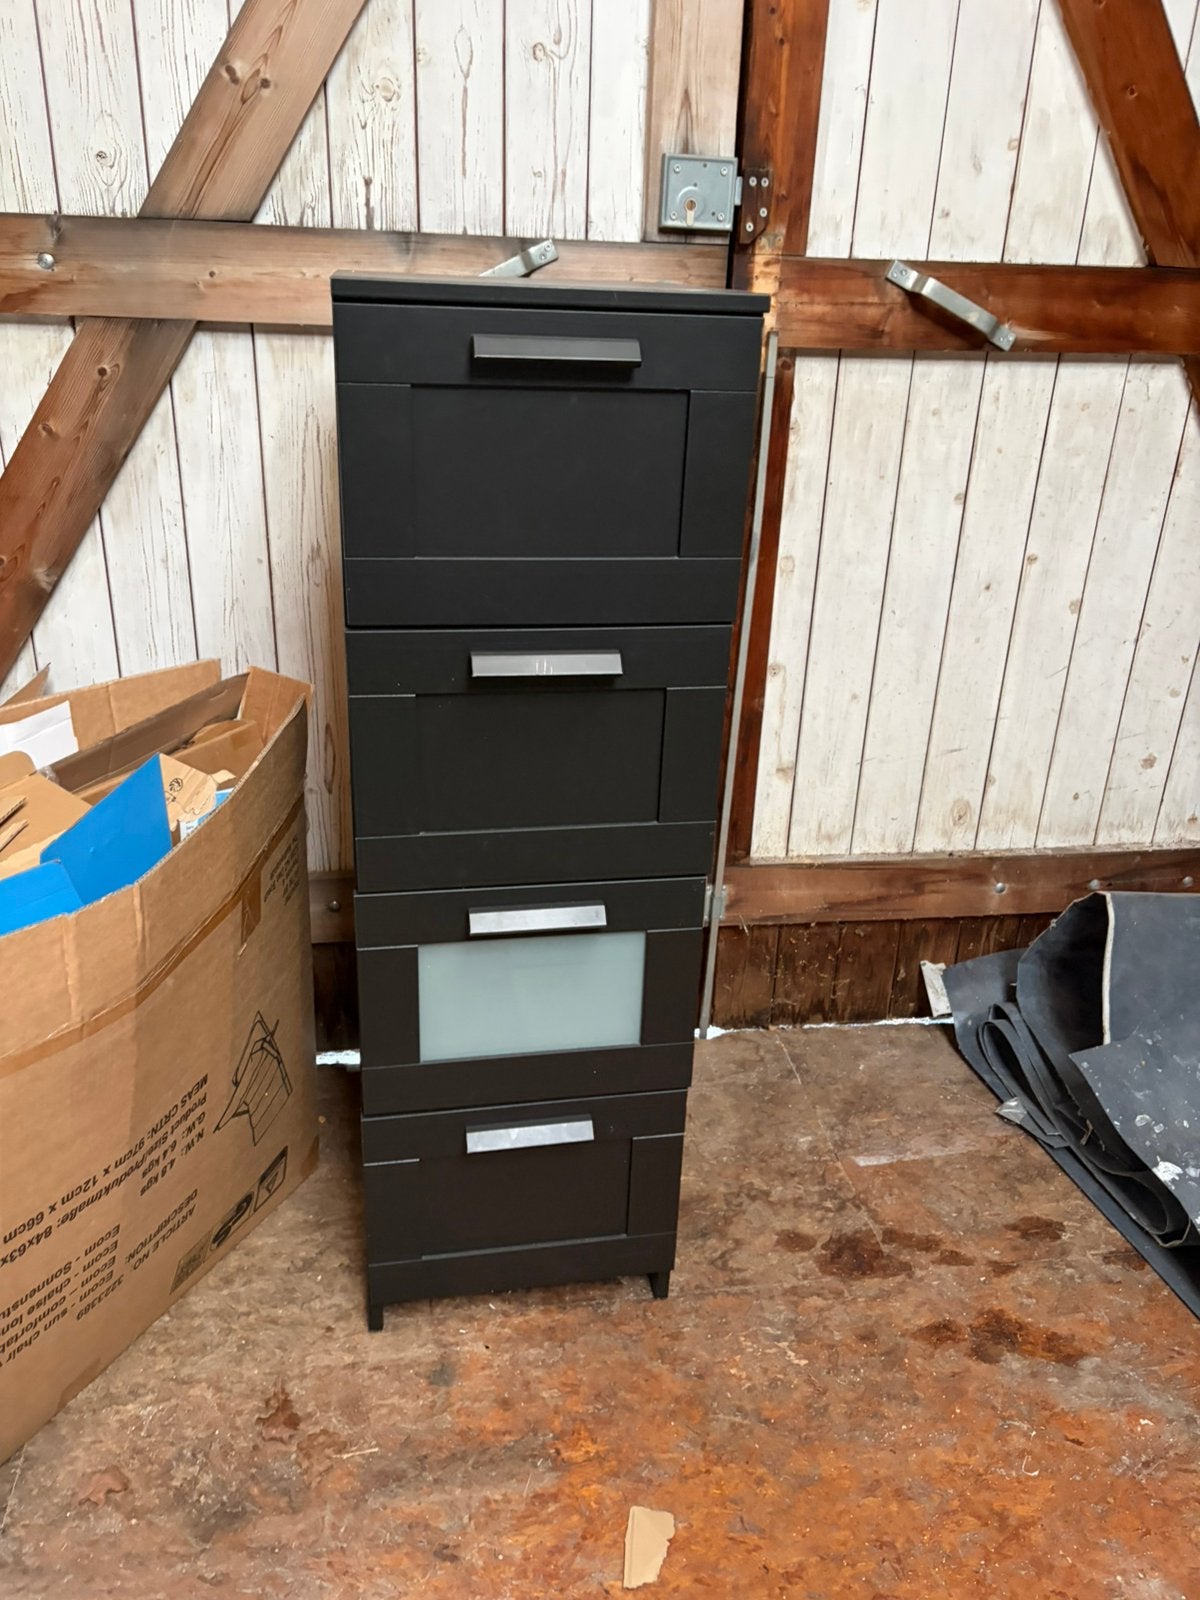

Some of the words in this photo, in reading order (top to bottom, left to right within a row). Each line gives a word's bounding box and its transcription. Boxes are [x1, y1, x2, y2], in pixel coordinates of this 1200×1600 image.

[180, 1073, 208, 1108] MEAS
[147, 1105, 178, 1140] CRTN:
[170, 1092, 207, 1131] Product
[114, 1137, 145, 1169] 97cm
[162, 1139, 178, 1160] 6.4
[102, 1166, 111, 1177] x
[141, 1157, 160, 1179] kgs
[161, 1157, 176, 1178] 4.8
[61, 1174, 99, 1205] 12cm
[140, 1175, 159, 1196] kgs
[48, 1203, 57, 1215] x
[3, 1211, 45, 1245] 66cm
[84, 1224, 120, 1257] Ecom
[125, 1188, 198, 1265] DESCRIPTION:
[152, 1204, 196, 1249] ARTICLE
[80, 1255, 116, 1288] Ecom
[82, 1239, 119, 1273] Ecom
[27, 1277, 71, 1316] chaise
[76, 1273, 124, 1321] 3223389
[79, 1269, 114, 1302] Ecom
[44, 1307, 68, 1331] sun
[6, 1330, 40, 1363] chair
